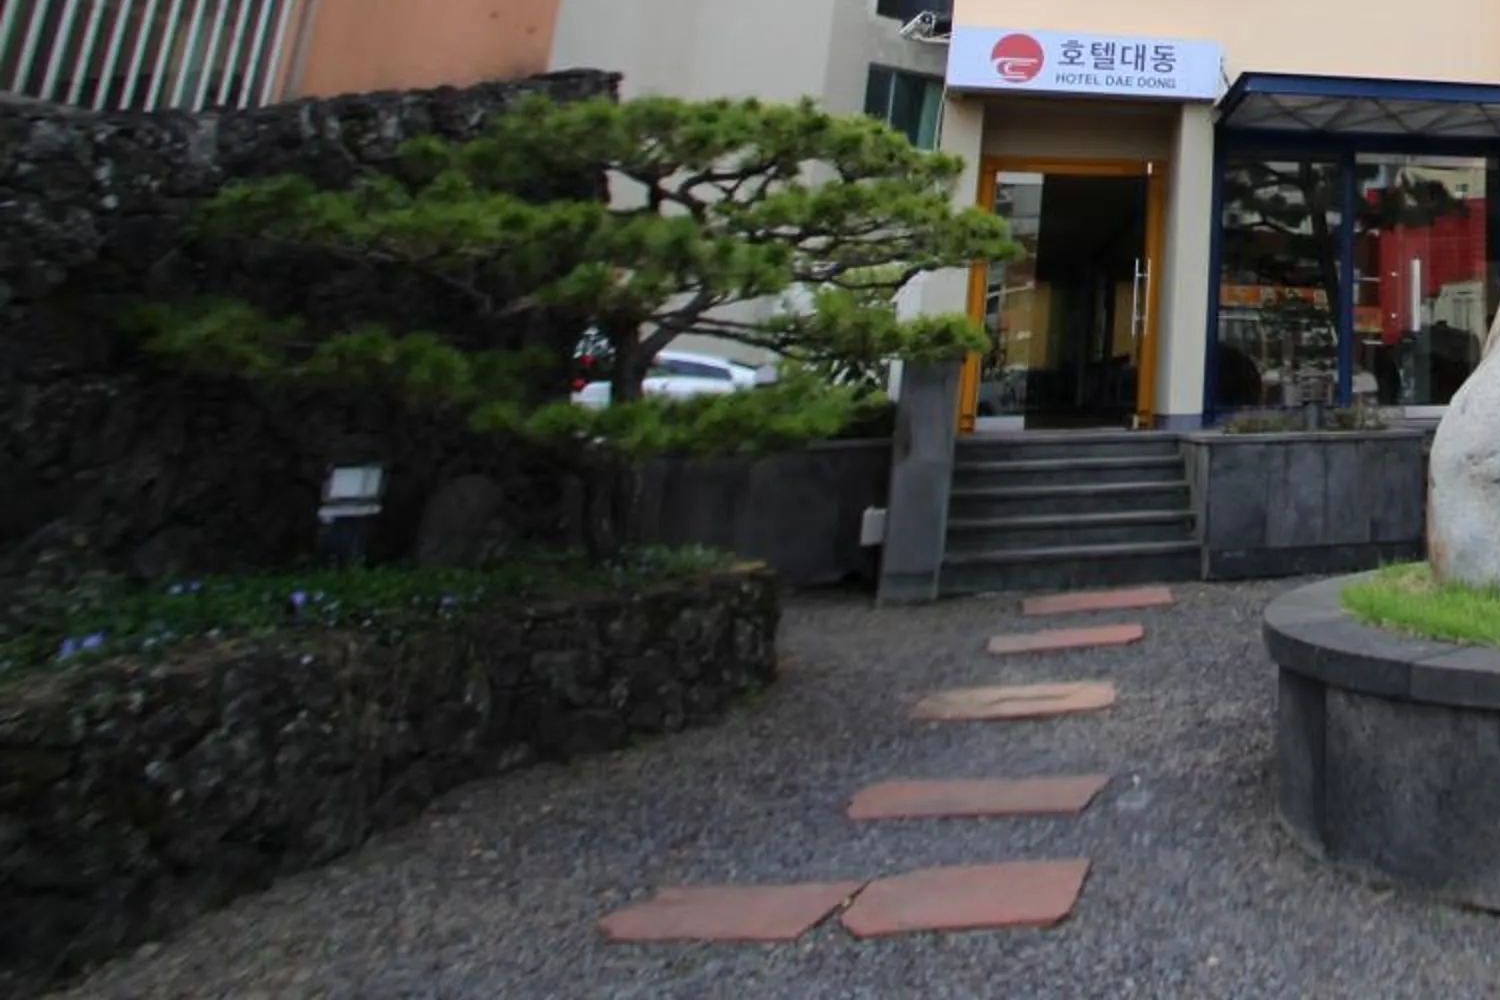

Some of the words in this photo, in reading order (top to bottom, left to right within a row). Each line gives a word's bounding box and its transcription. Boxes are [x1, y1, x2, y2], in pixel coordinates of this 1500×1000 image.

[1057, 39, 1177, 73] 호텔대동
[1055, 72, 1101, 86] HOTEL
[1104, 75, 1133, 88] DAE
[1136, 76, 1177, 90] DONG
